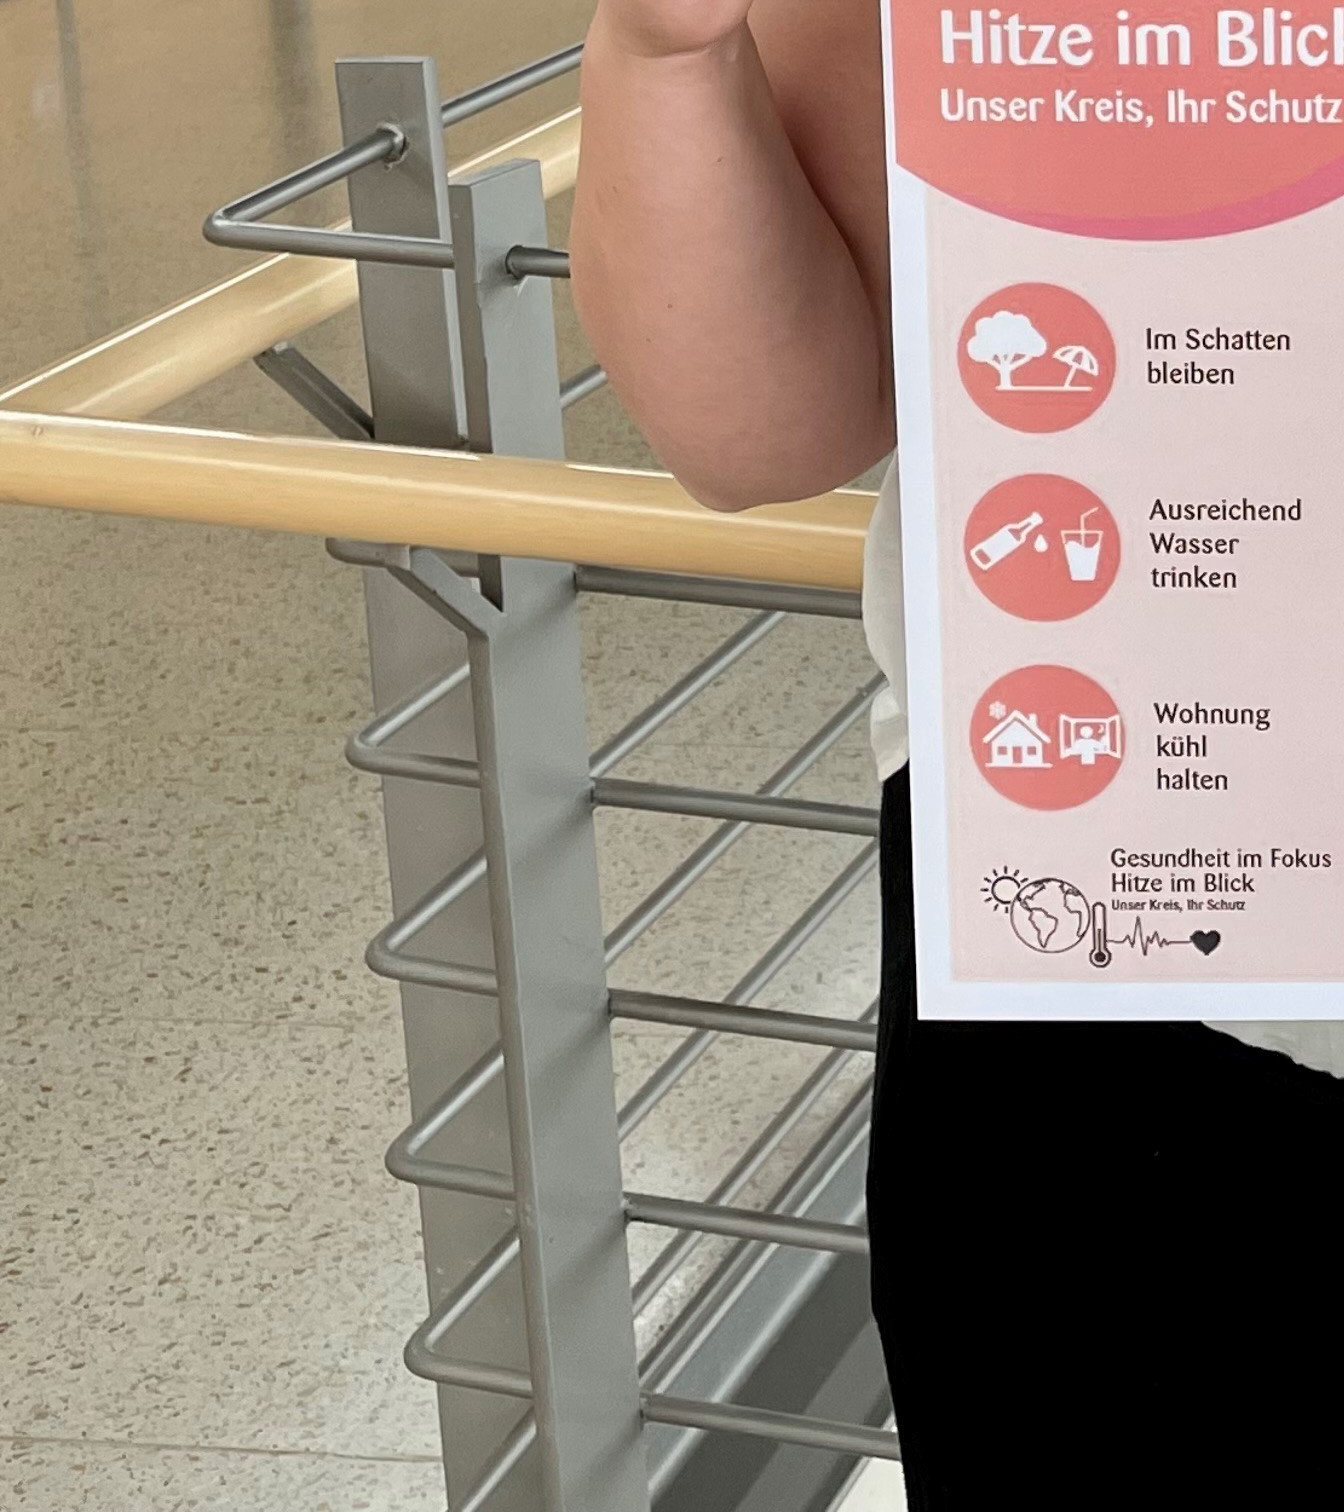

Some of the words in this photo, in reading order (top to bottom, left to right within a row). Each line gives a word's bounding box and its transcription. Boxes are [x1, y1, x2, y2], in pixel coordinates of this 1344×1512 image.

[940, 8, 1094, 66] Hitze
[1116, 9, 1191, 66] im
[940, 87, 1045, 122] Unser
[1054, 89, 1154, 128] Kreis,
[1167, 88, 1217, 123] Ihr
[1226, 88, 1343, 123] Schutz
[1146, 327, 1176, 350] Im
[1185, 327, 1291, 351] Schatten
[1147, 360, 1235, 385] bleiben
[1149, 497, 1302, 521] Ausreichend
[1149, 532, 1240, 555] Wasser
[1151, 564, 1237, 589] trinken
[1153, 701, 1271, 731] Wohnung
[1156, 734, 1207, 757] kühl
[1157, 767, 1228, 791] halten
[1110, 847, 1231, 868] Gesundheit
[1237, 848, 1262, 868] im
[1271, 848, 1332, 868] Fokus
[1111, 872, 1163, 893] Hitze
[1170, 872, 1196, 893] im
[1204, 872, 1256, 893] Blick
[1111, 899, 1147, 911] Unser
[1149, 899, 1183, 913] Kreis,
[1186, 899, 1204, 910] Ihr
[1206, 898, 1246, 911] Schutz
